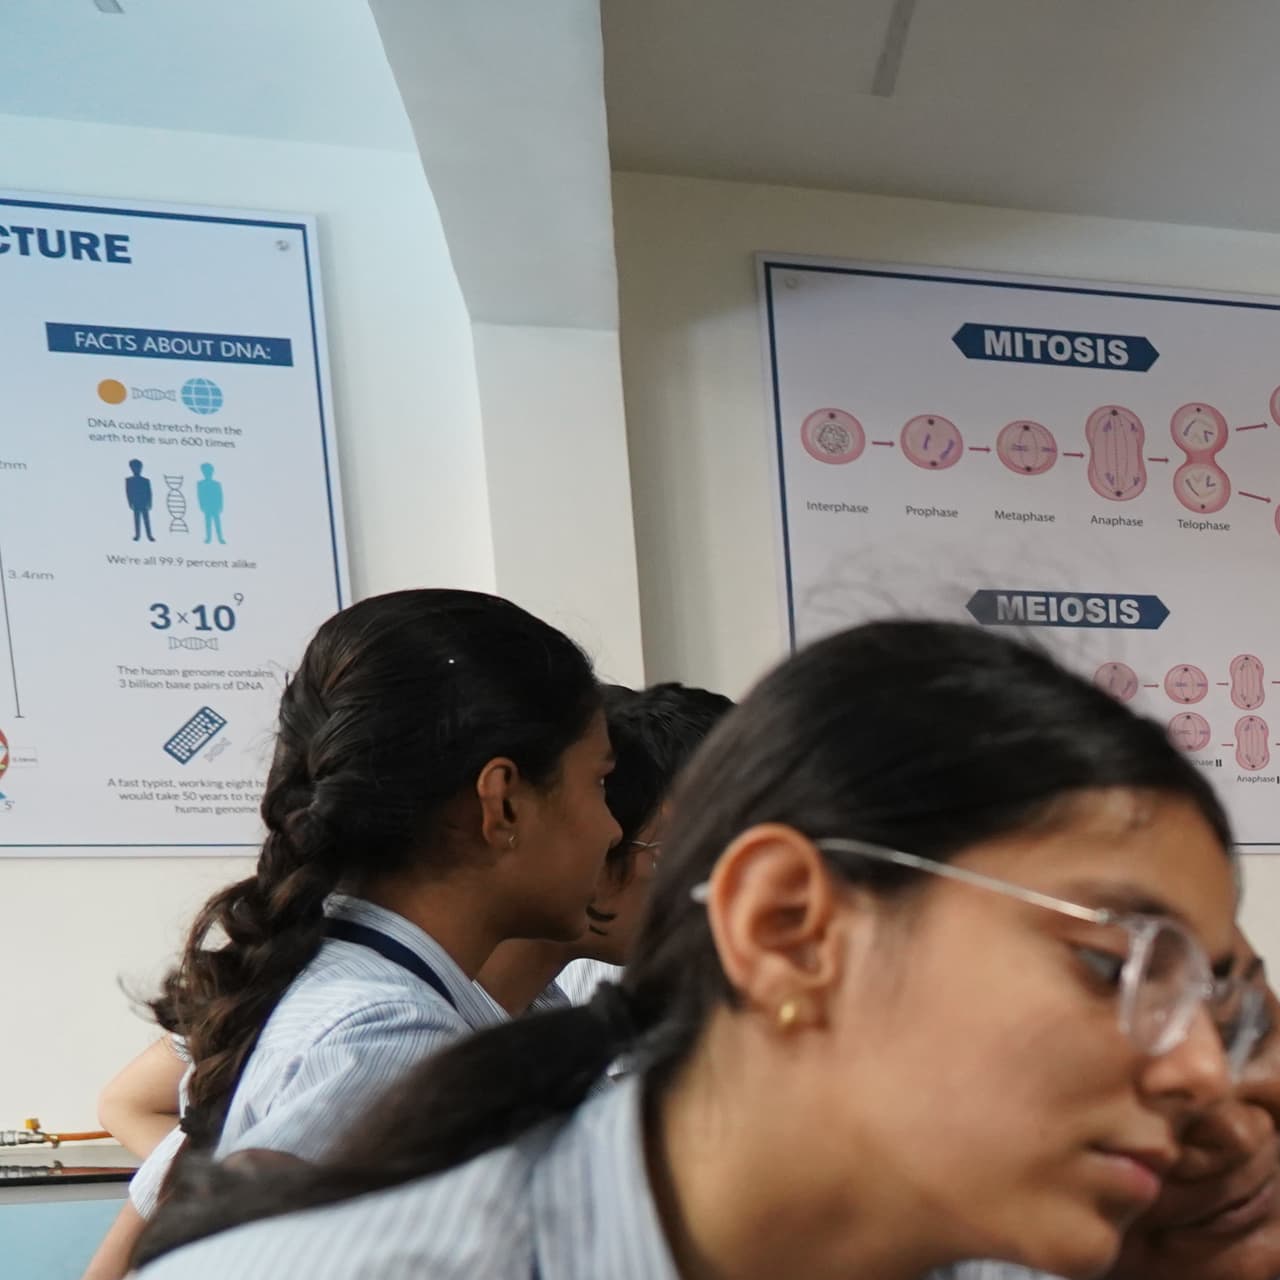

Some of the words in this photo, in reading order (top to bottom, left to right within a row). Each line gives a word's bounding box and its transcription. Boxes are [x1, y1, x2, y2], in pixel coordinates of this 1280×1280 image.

[74, 331, 137, 351] FACTS
[144, 336, 215, 356] ABOUT
[220, 341, 271, 360] DNA:
[983, 329, 1129, 366] MITOSIS
[88, 417, 117, 429] DNA
[118, 420, 150, 431] could
[151, 421, 193, 433] stretch
[194, 423, 223, 434] from
[224, 425, 243, 436] the
[89, 432, 121, 442] earth
[122, 433, 135, 443] to
[136, 434, 156, 445] the
[158, 437, 179, 446] sun
[180, 436, 203, 447] 600
[205, 438, 236, 448] times
[806, 501, 869, 514] Interphase
[905, 505, 959, 518] Prophase
[994, 509, 1056, 523] Metaphase
[1090, 514, 1144, 527] Anaphase
[1177, 519, 1231, 532] Telophase
[106, 554, 141, 565] We're
[143, 556, 157, 566] all
[159, 556, 184, 567] 99.9
[186, 558, 228, 569] percent
[231, 559, 257, 569] alike
[996, 595, 1140, 625] MEIOSIS
[117, 665, 139, 676] The
[141, 666, 179, 677] human
[182, 668, 226, 679] genome
[227, 668, 274, 678] contains
[119, 679, 127, 688] 3
[128, 679, 164, 689] billion
[165, 680, 191, 690] base
[193, 681, 221, 691] pairs
[223, 681, 235, 690] of
[237, 681, 264, 691] DNA
[107, 778, 116, 787] A
[118, 778, 139, 788] fast
[178, 779, 223, 790] working
[225, 779, 253, 790] eight
[1236, 775, 1276, 785] Anaphase
[119, 791, 154, 801] would
[156, 791, 181, 801] take
[182, 791, 197, 801] 50
[199, 793, 229, 803] years
[230, 792, 244, 801] to
[175, 805, 213, 815] human
[215, 806, 257, 816] genome
